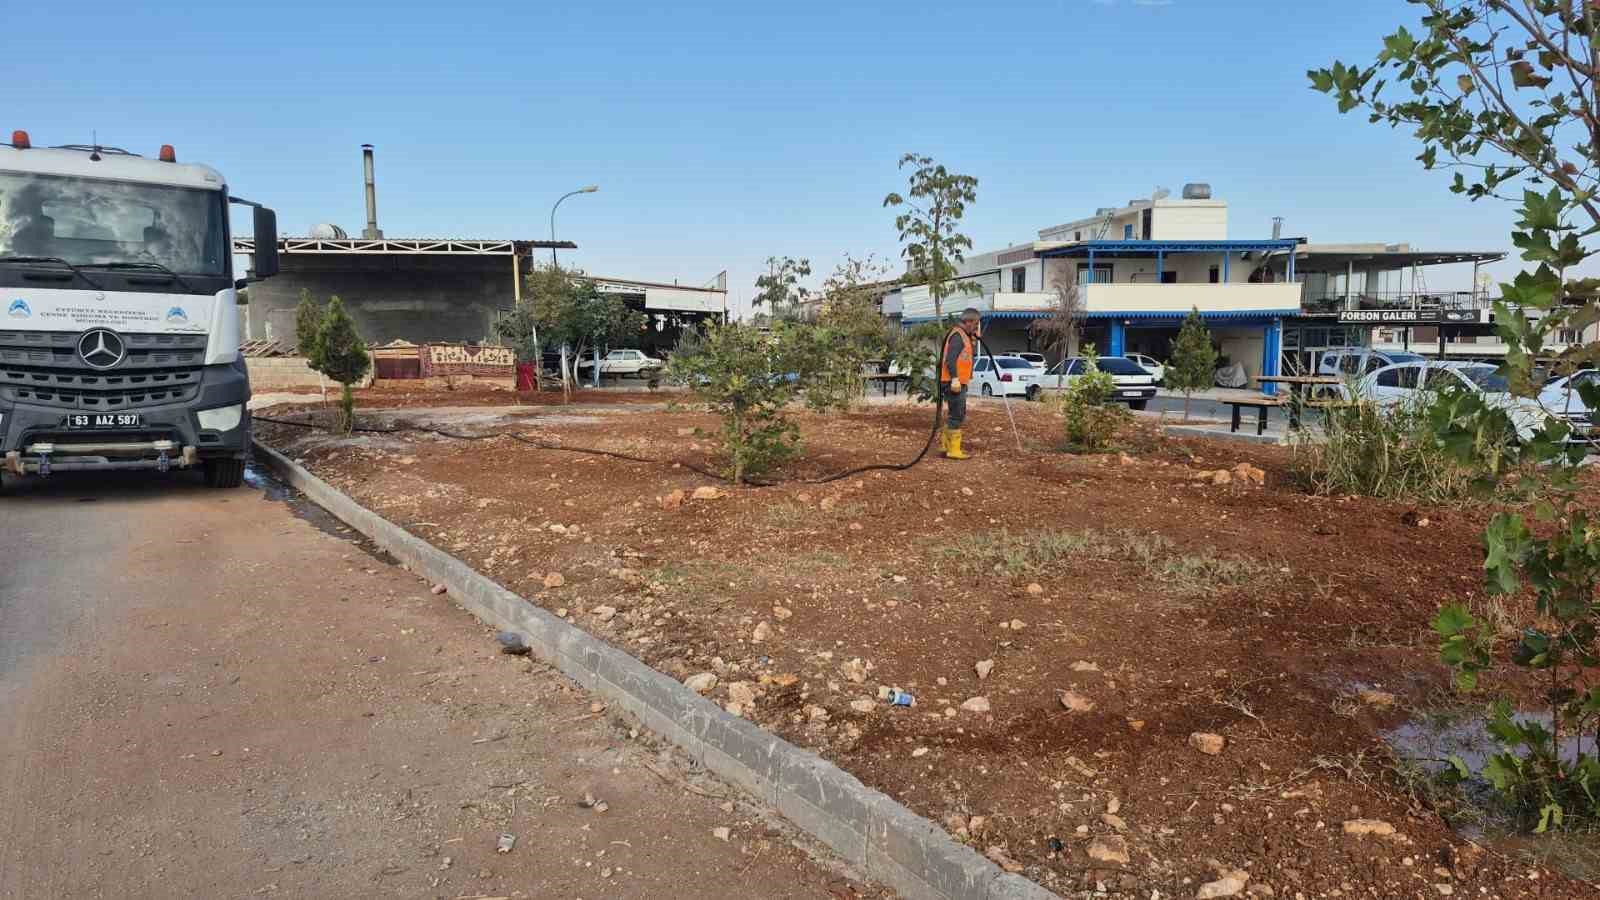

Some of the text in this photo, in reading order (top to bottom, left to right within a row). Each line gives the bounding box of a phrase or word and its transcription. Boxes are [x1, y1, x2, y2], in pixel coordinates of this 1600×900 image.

[1340, 311, 1380, 321] FORSON
[75, 415, 89, 425] 63
[95, 415, 115, 425] AAZ
